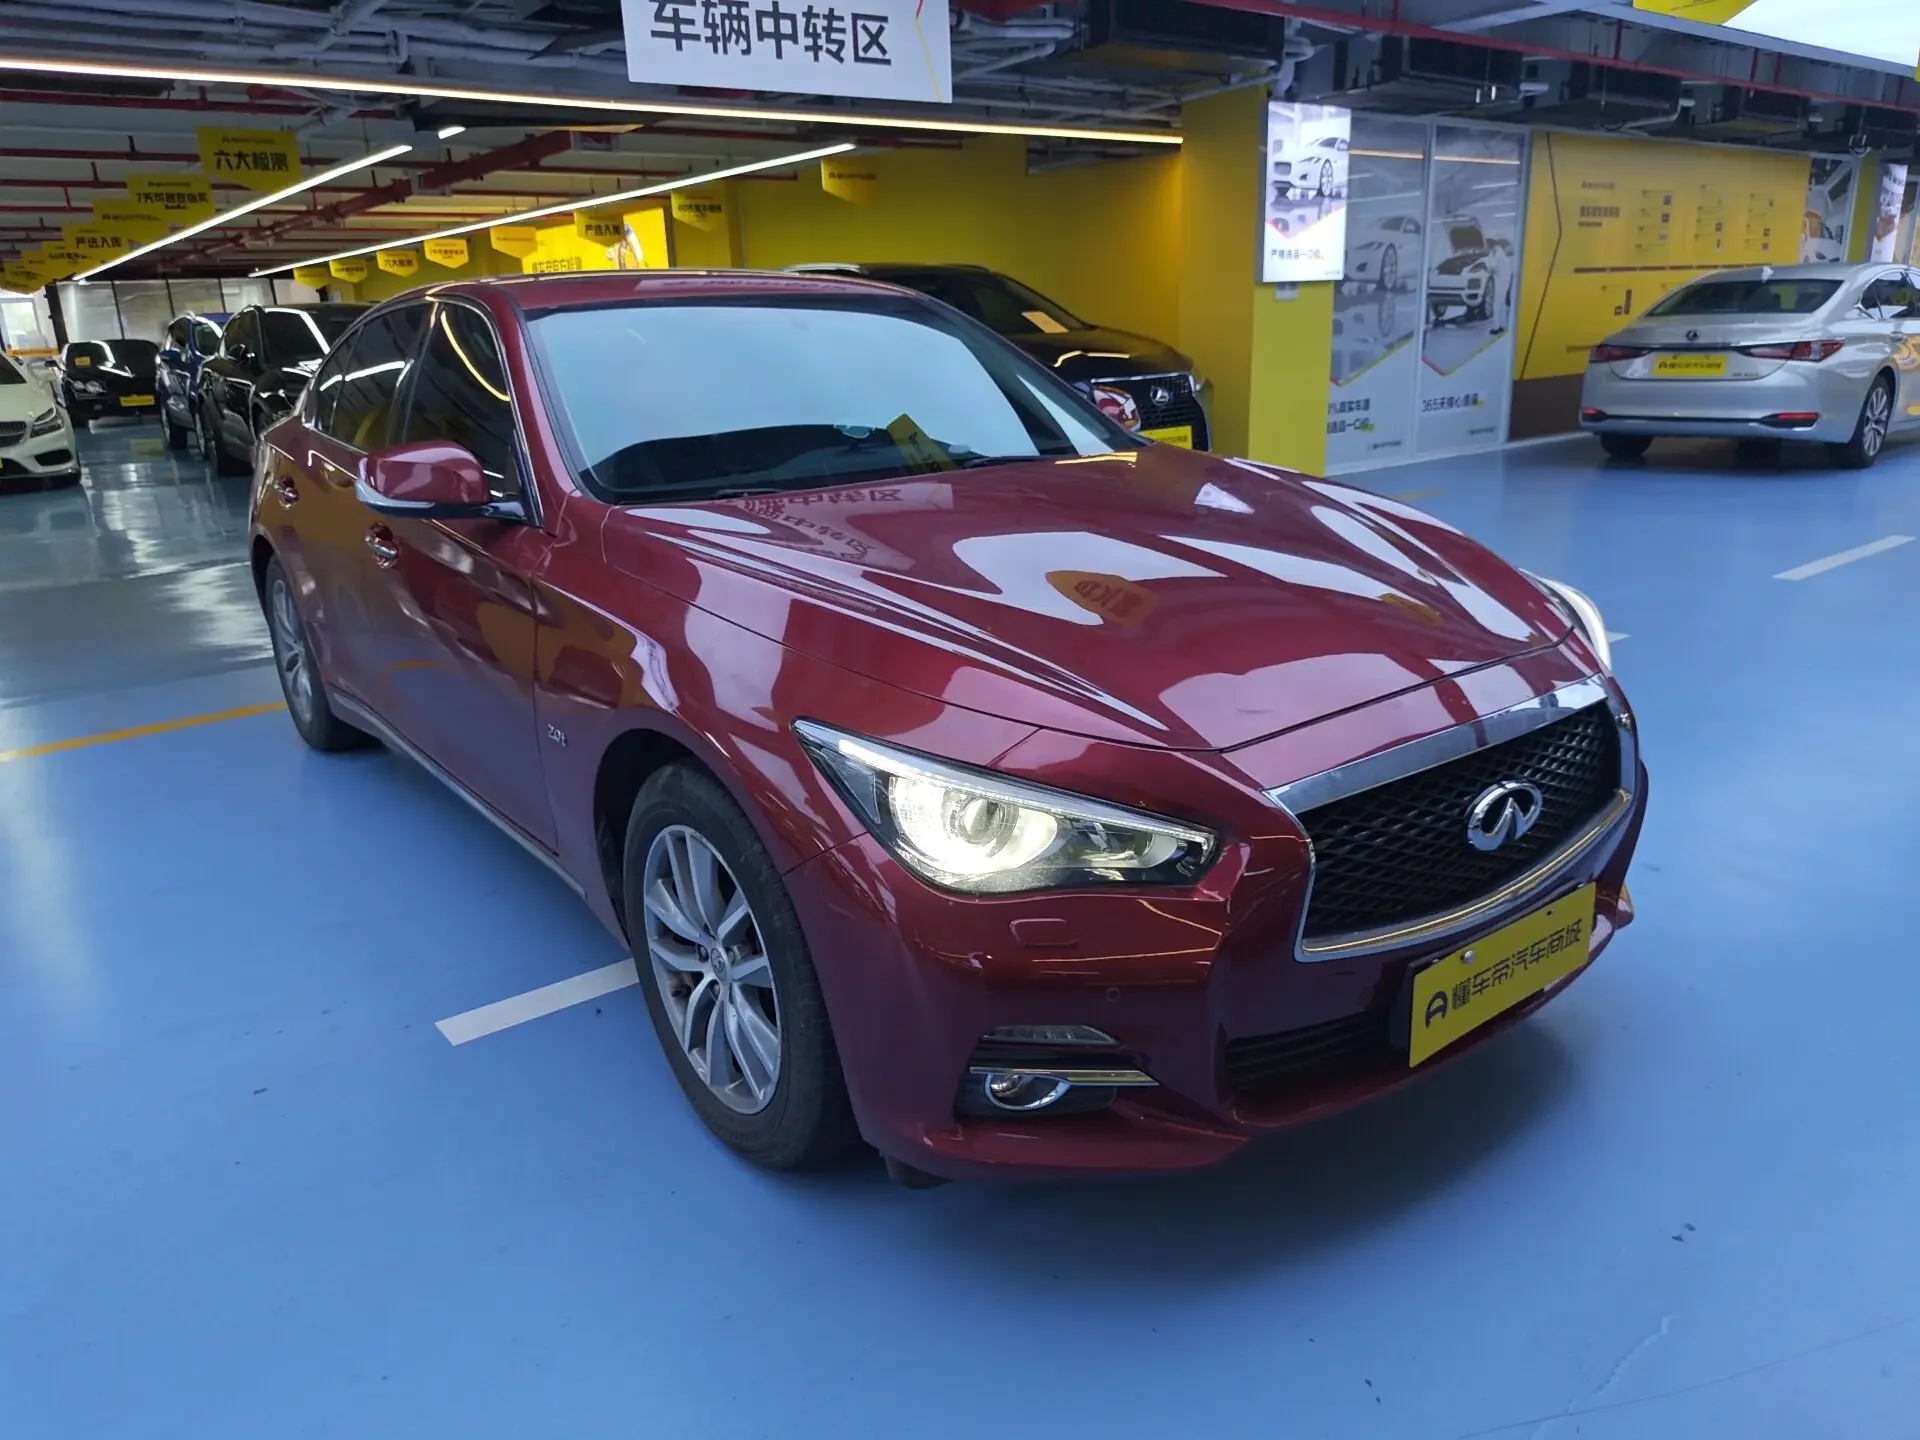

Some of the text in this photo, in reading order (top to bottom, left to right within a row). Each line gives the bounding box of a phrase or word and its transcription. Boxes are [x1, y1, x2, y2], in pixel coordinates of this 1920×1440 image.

[649, 0, 891, 66] 车辆中转区
[213, 150, 288, 172] 六大检测
[75, 236, 124, 249] 严选入库
[1451, 919, 1583, 1010] 懂车帝汽车商城
